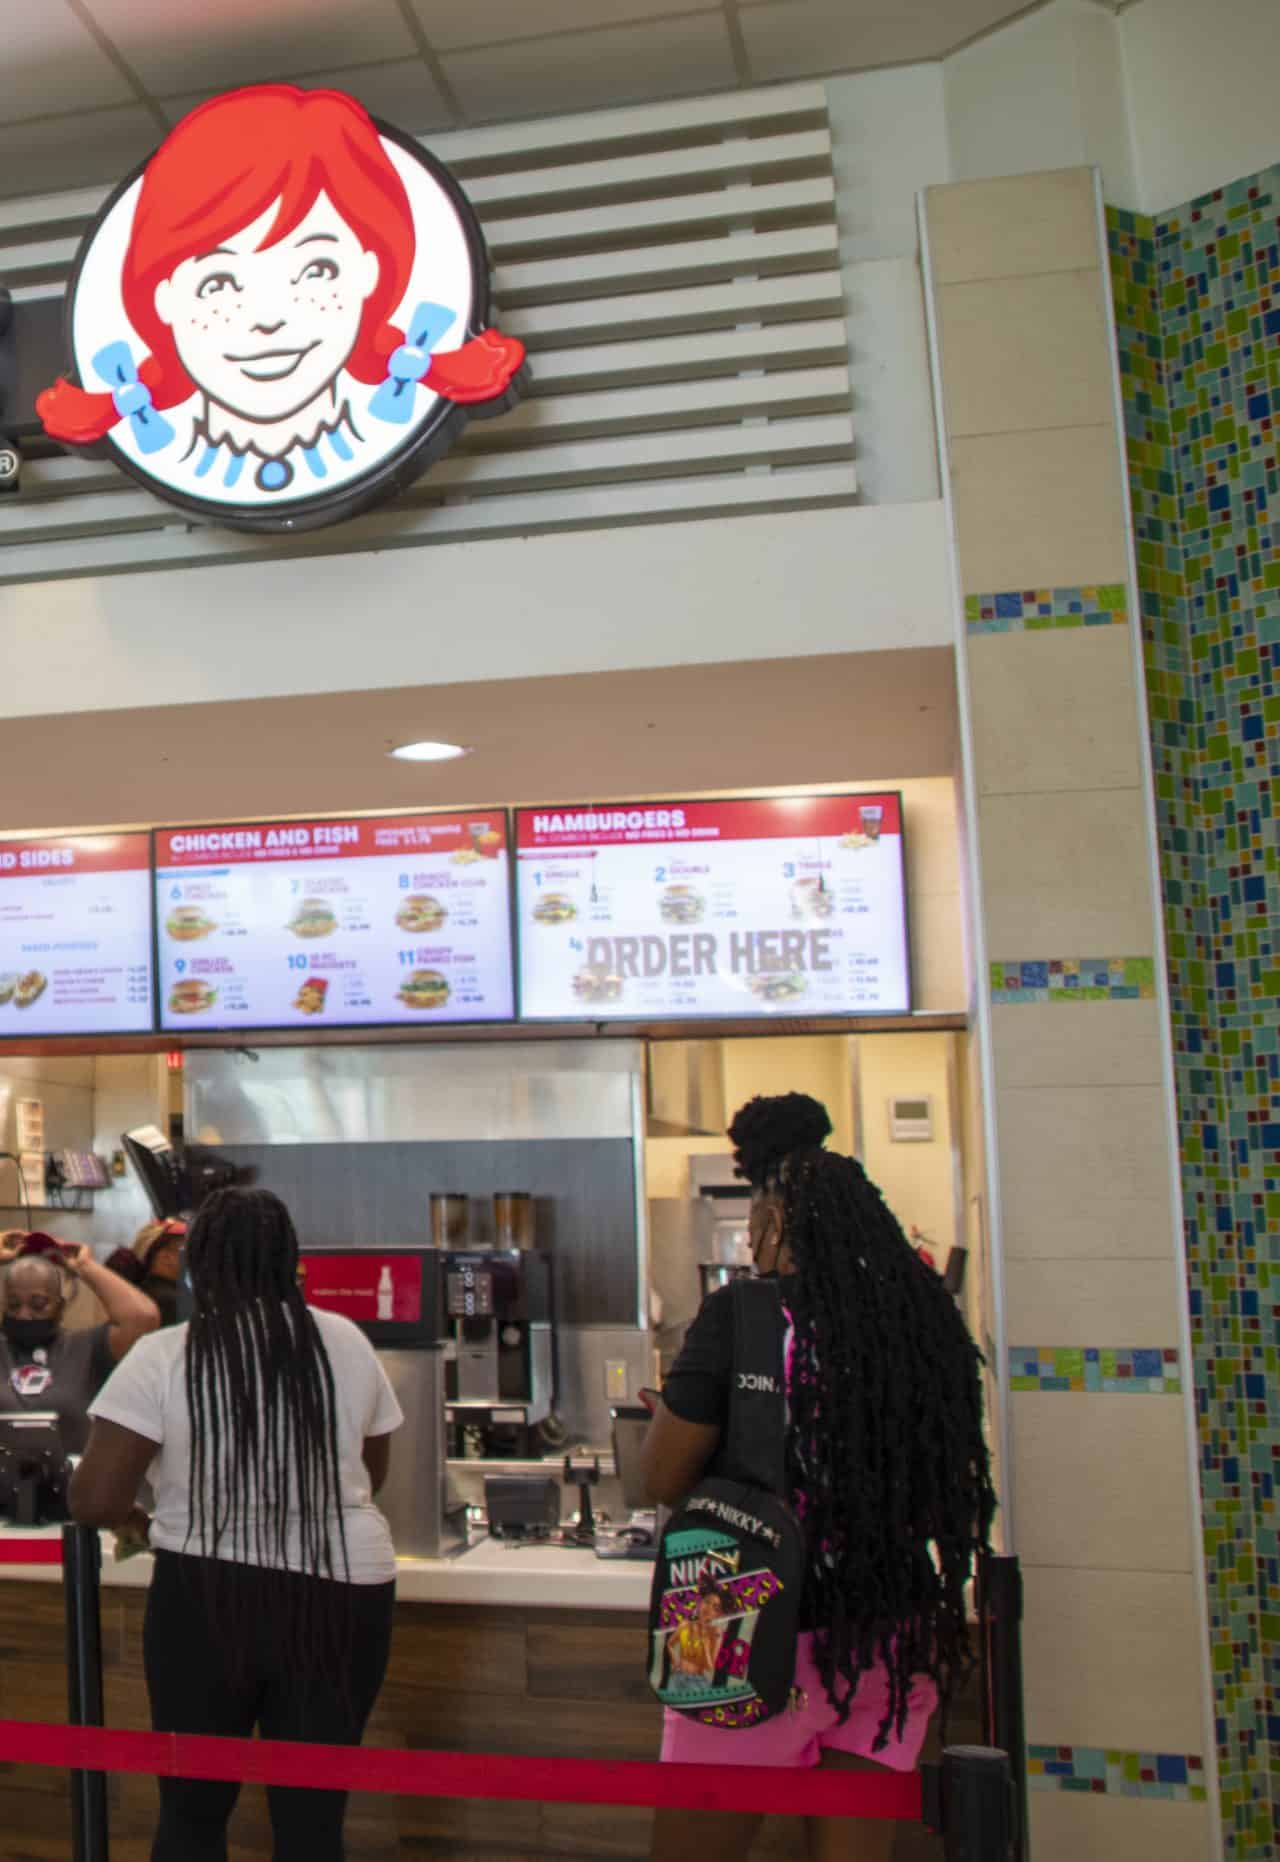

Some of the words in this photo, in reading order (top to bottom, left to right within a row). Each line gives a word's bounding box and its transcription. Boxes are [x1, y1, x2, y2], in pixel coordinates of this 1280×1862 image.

[533, 810, 686, 833] HAMBURGERS
[170, 831, 263, 853] CHICKEN
[265, 828, 311, 849] AND
[312, 825, 359, 846] FISH
[19, 849, 75, 869] SIDES
[655, 866, 666, 882] 2
[288, 953, 307, 969] 10
[587, 934, 718, 978] ORDER
[730, 929, 833, 974] HERE
[174, 959, 186, 973] 9
[717, 1502, 763, 1534] NIKKY
